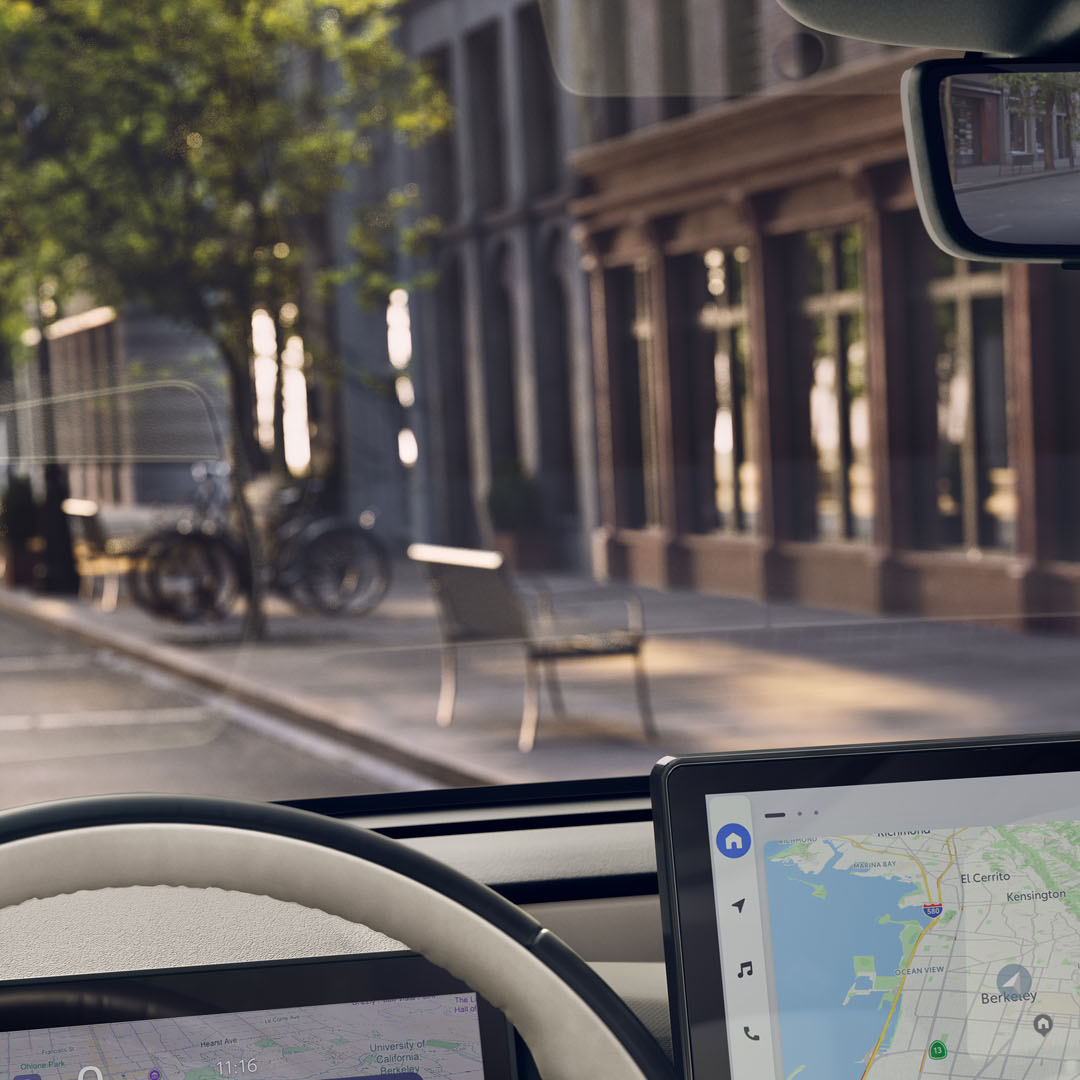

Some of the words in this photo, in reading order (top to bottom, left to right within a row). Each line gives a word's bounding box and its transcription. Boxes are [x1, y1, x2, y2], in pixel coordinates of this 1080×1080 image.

[883, 860, 897, 868] BAY
[961, 874, 971, 883] El
[973, 872, 1011, 883] Cerrito
[1006, 890, 1067, 902] Kensington
[894, 968, 923, 976] OCEAN
[925, 966, 945, 974] VIEW
[981, 991, 1038, 1005] Berkeley
[369, 1041, 414, 1053] University
[416, 1039, 425, 1048] of
[933, 1046, 942, 1054] 13
[216, 1058, 258, 1075] 11:16
[380, 1065, 420, 1075] Berkeley
